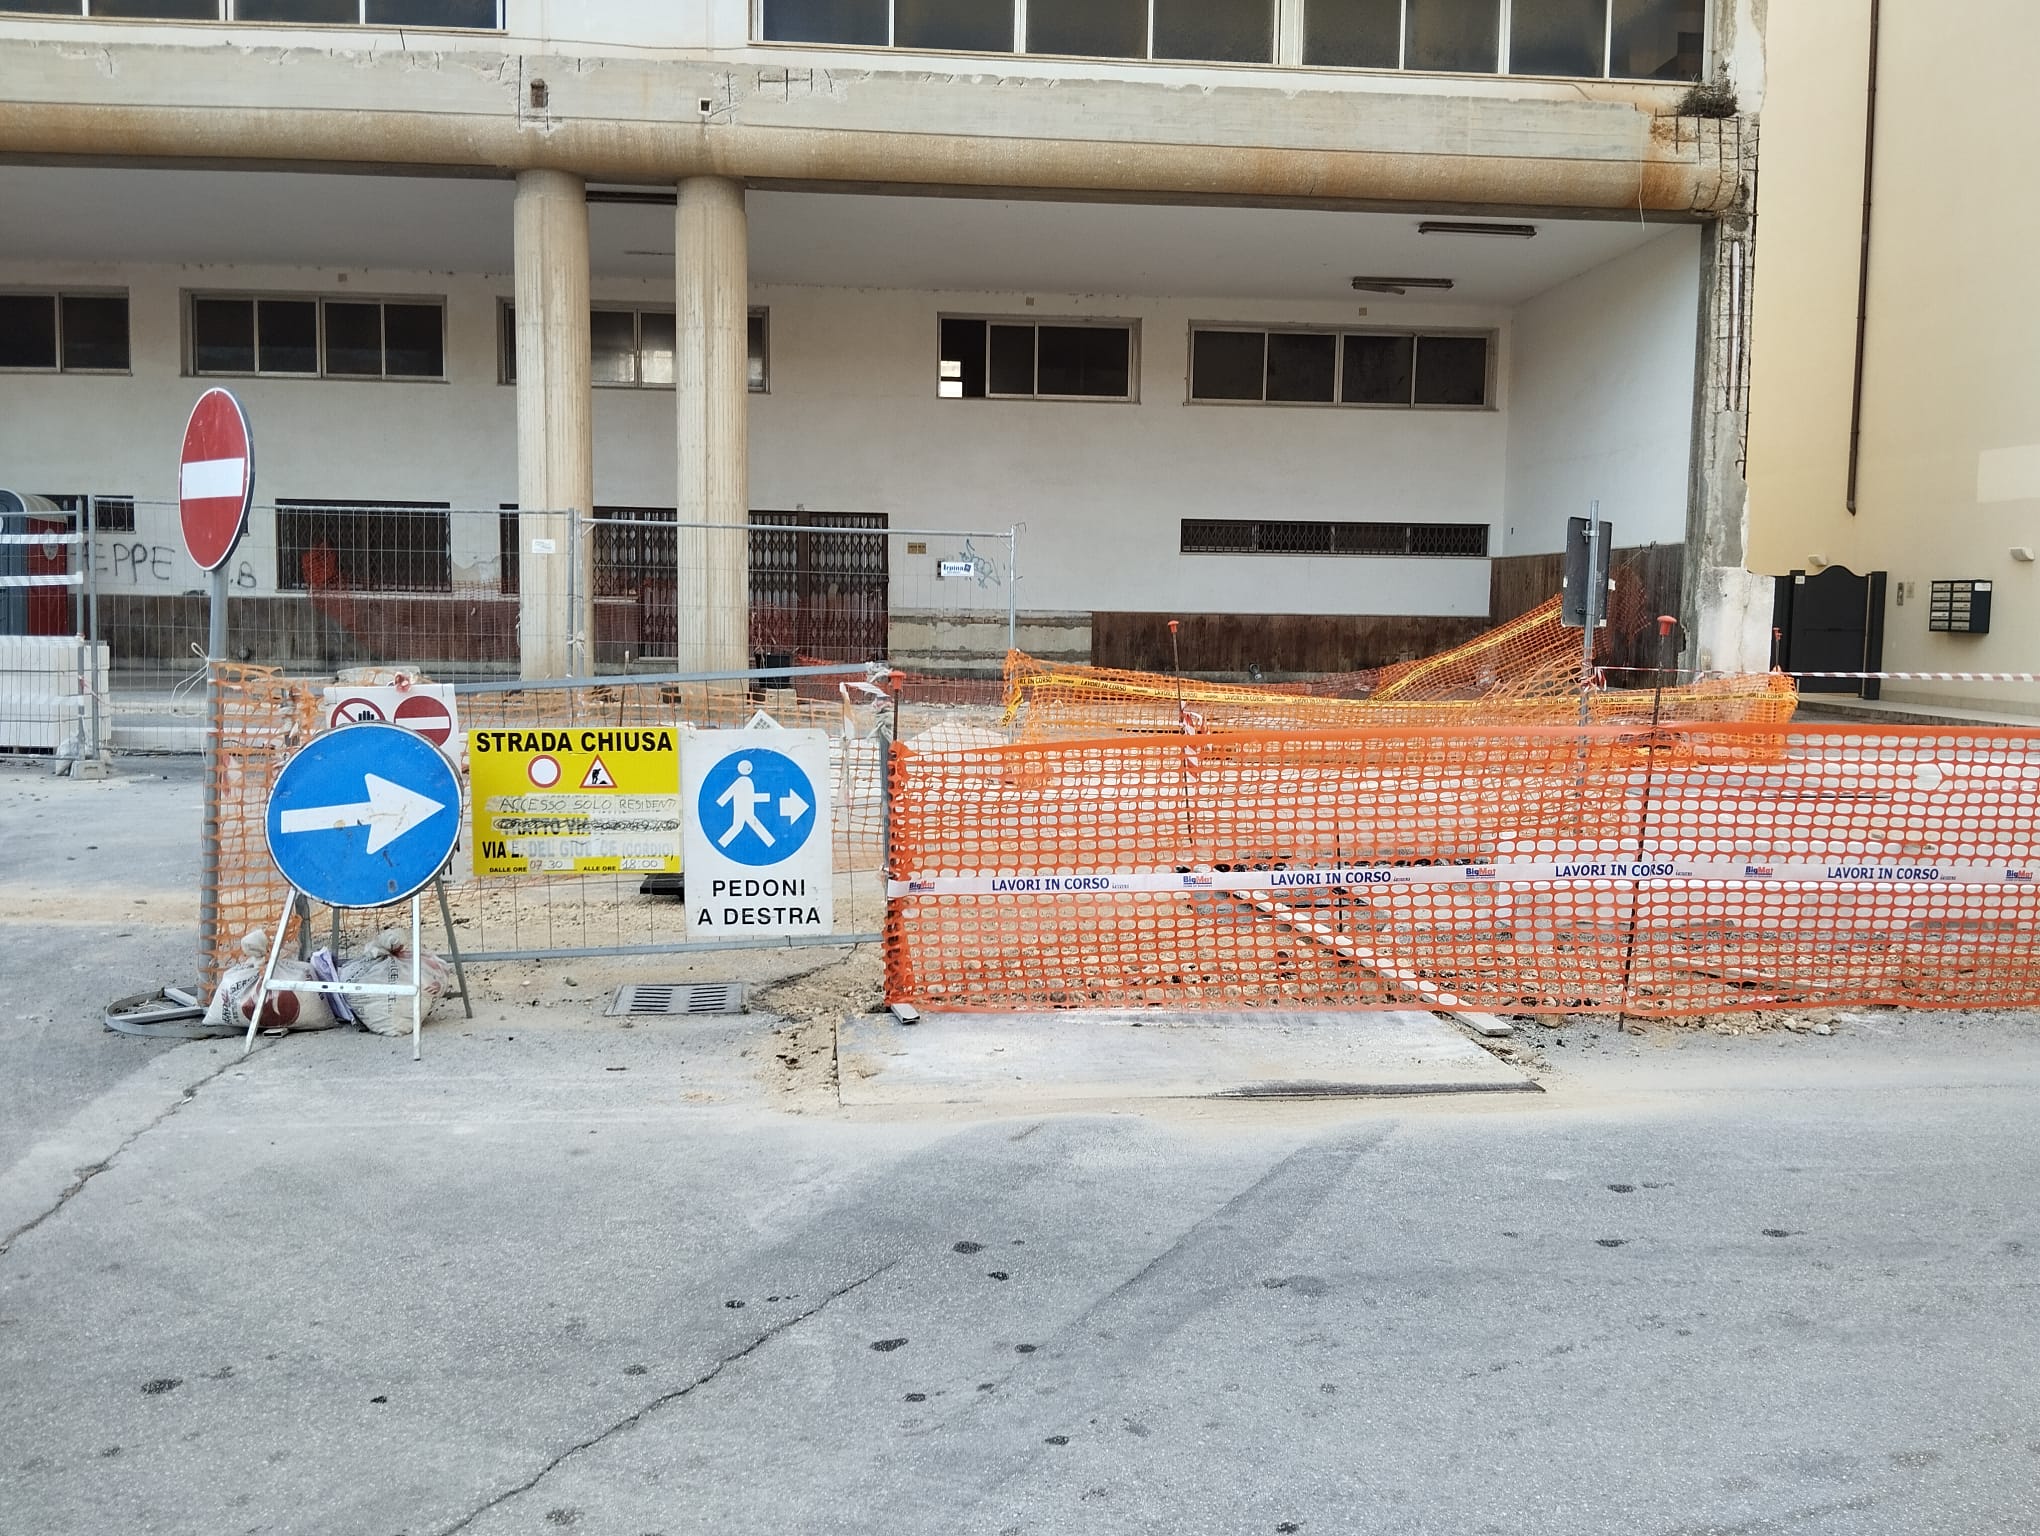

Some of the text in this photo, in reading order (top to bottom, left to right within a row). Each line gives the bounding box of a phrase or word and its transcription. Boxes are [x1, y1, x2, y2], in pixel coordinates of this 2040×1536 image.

[476, 731, 673, 752] STRADA CHIUSA
[499, 798, 567, 811] ACCESSO
[573, 799, 612, 810] SOLO
[482, 841, 507, 858] VIA
[528, 841, 556, 858] DEL
[1555, 864, 1606, 877] LAVORI
[1611, 864, 1627, 877] IN
[1631, 863, 1674, 877] CORSO
[1827, 866, 1875, 879] LAVORI
[1878, 867, 1893, 879] IN
[1896, 867, 1939, 880] CORSO
[992, 878, 1041, 891] LAVORI
[1045, 878, 1060, 891] IN
[1064, 877, 1110, 890] CORSO
[1271, 872, 1321, 886] LAVORI
[1325, 872, 1341, 885] IN
[1346, 871, 1391, 884] CORSO
[712, 879, 805, 897] PEDONI
[697, 907, 821, 926] A DESTRA
